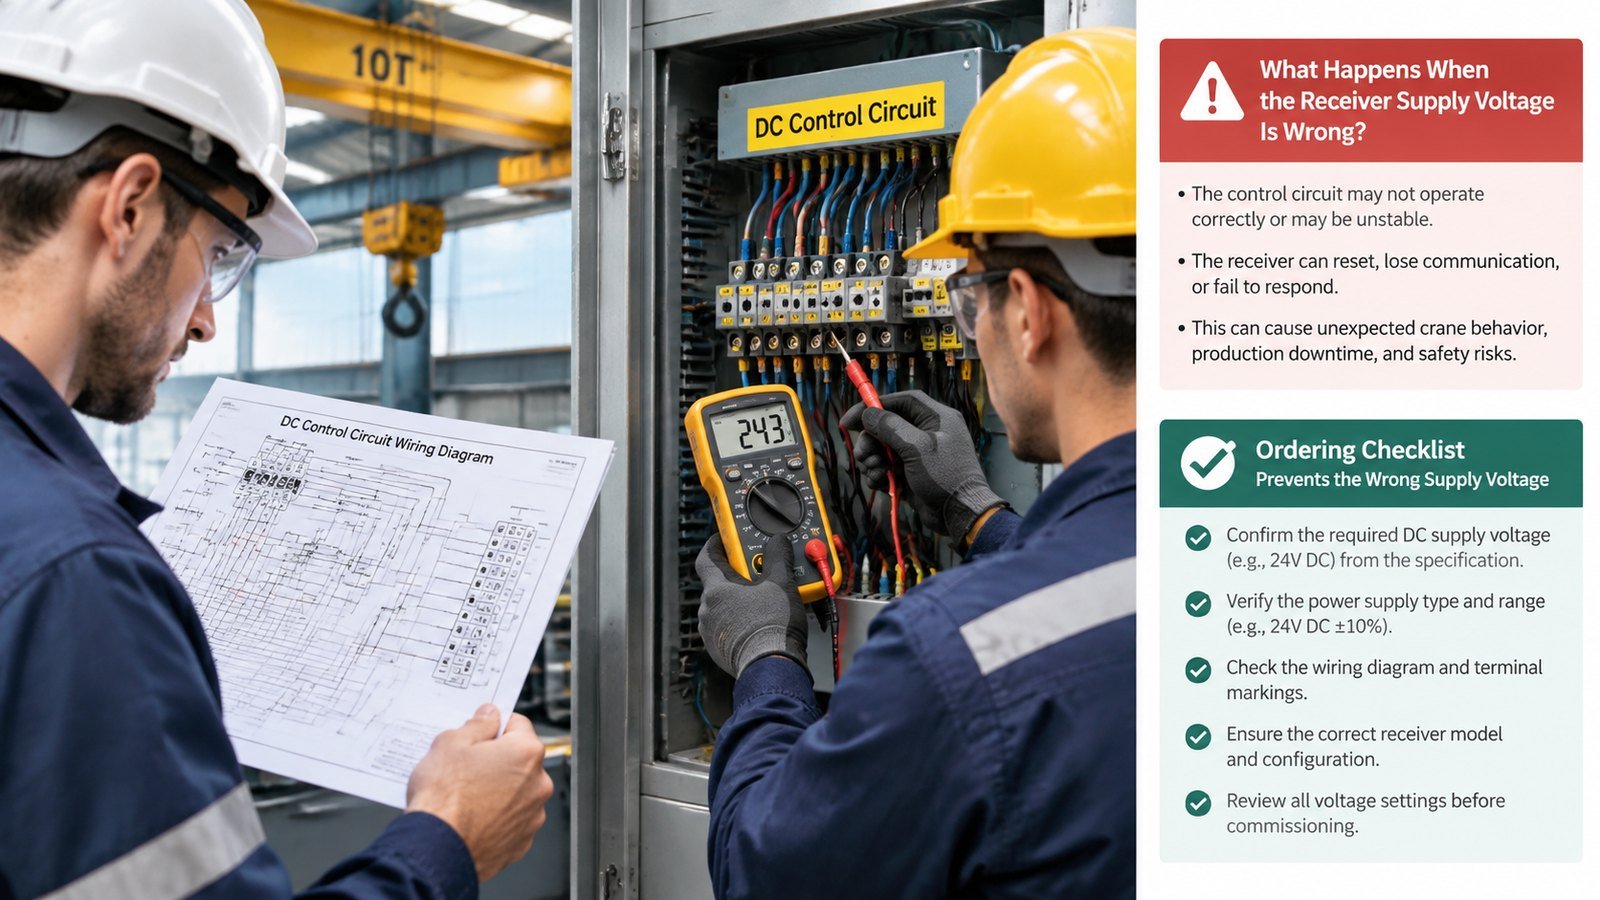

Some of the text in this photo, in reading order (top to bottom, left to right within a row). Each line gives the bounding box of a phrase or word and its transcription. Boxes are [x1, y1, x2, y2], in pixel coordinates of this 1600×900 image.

[352, 43, 415, 86] 10T
[756, 95, 937, 139] DC Control Circuit
[280, 415, 494, 465] DC Control Circuit Wiring Diagram
